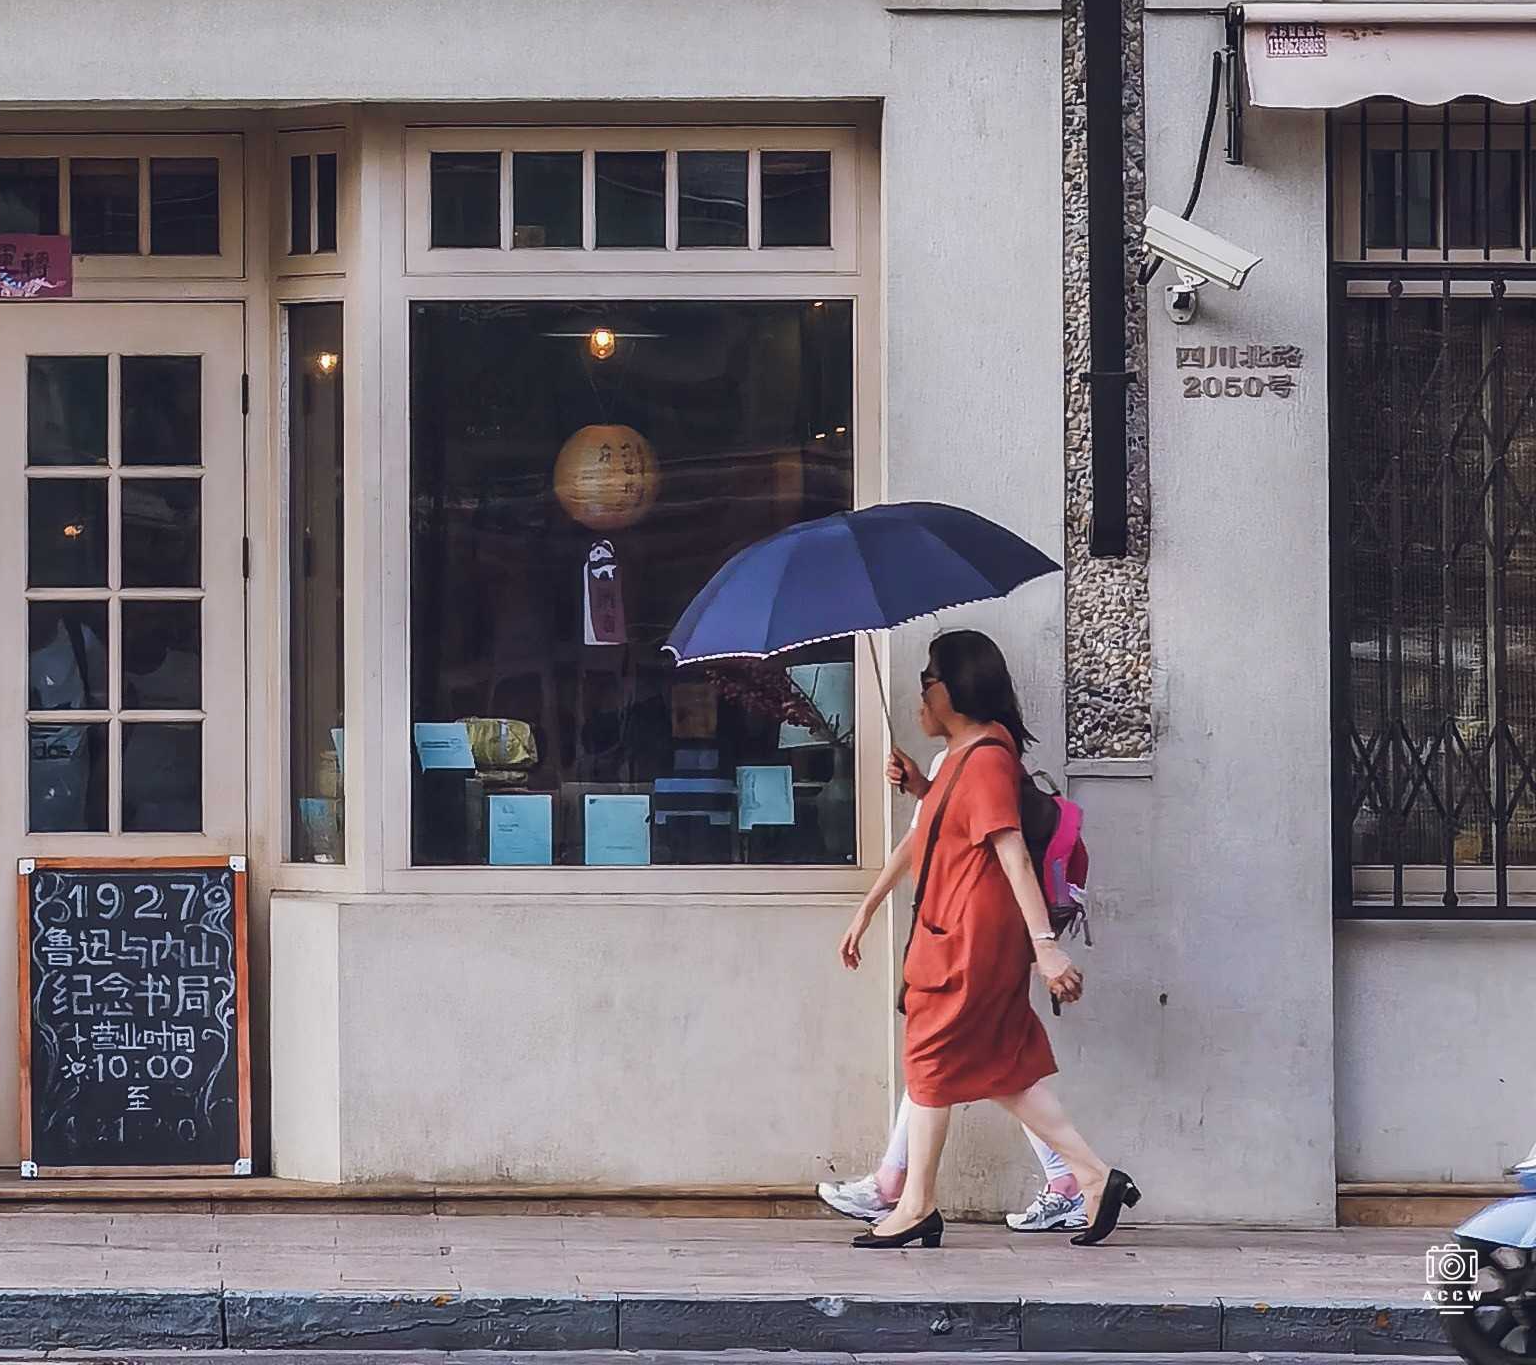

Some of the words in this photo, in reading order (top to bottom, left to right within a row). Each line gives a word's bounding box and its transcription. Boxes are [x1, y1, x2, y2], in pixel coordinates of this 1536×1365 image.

[1176, 345, 1304, 370] 四川北路
[1183, 374, 1297, 399] 2050号
[41, 926, 220, 970] 鲁迅与内山
[52, 972, 210, 1018] 纪念书局
[90, 1020, 195, 1053] 营业时间
[92, 1054, 193, 1082] 10:00
[125, 1085, 153, 1111] 至
